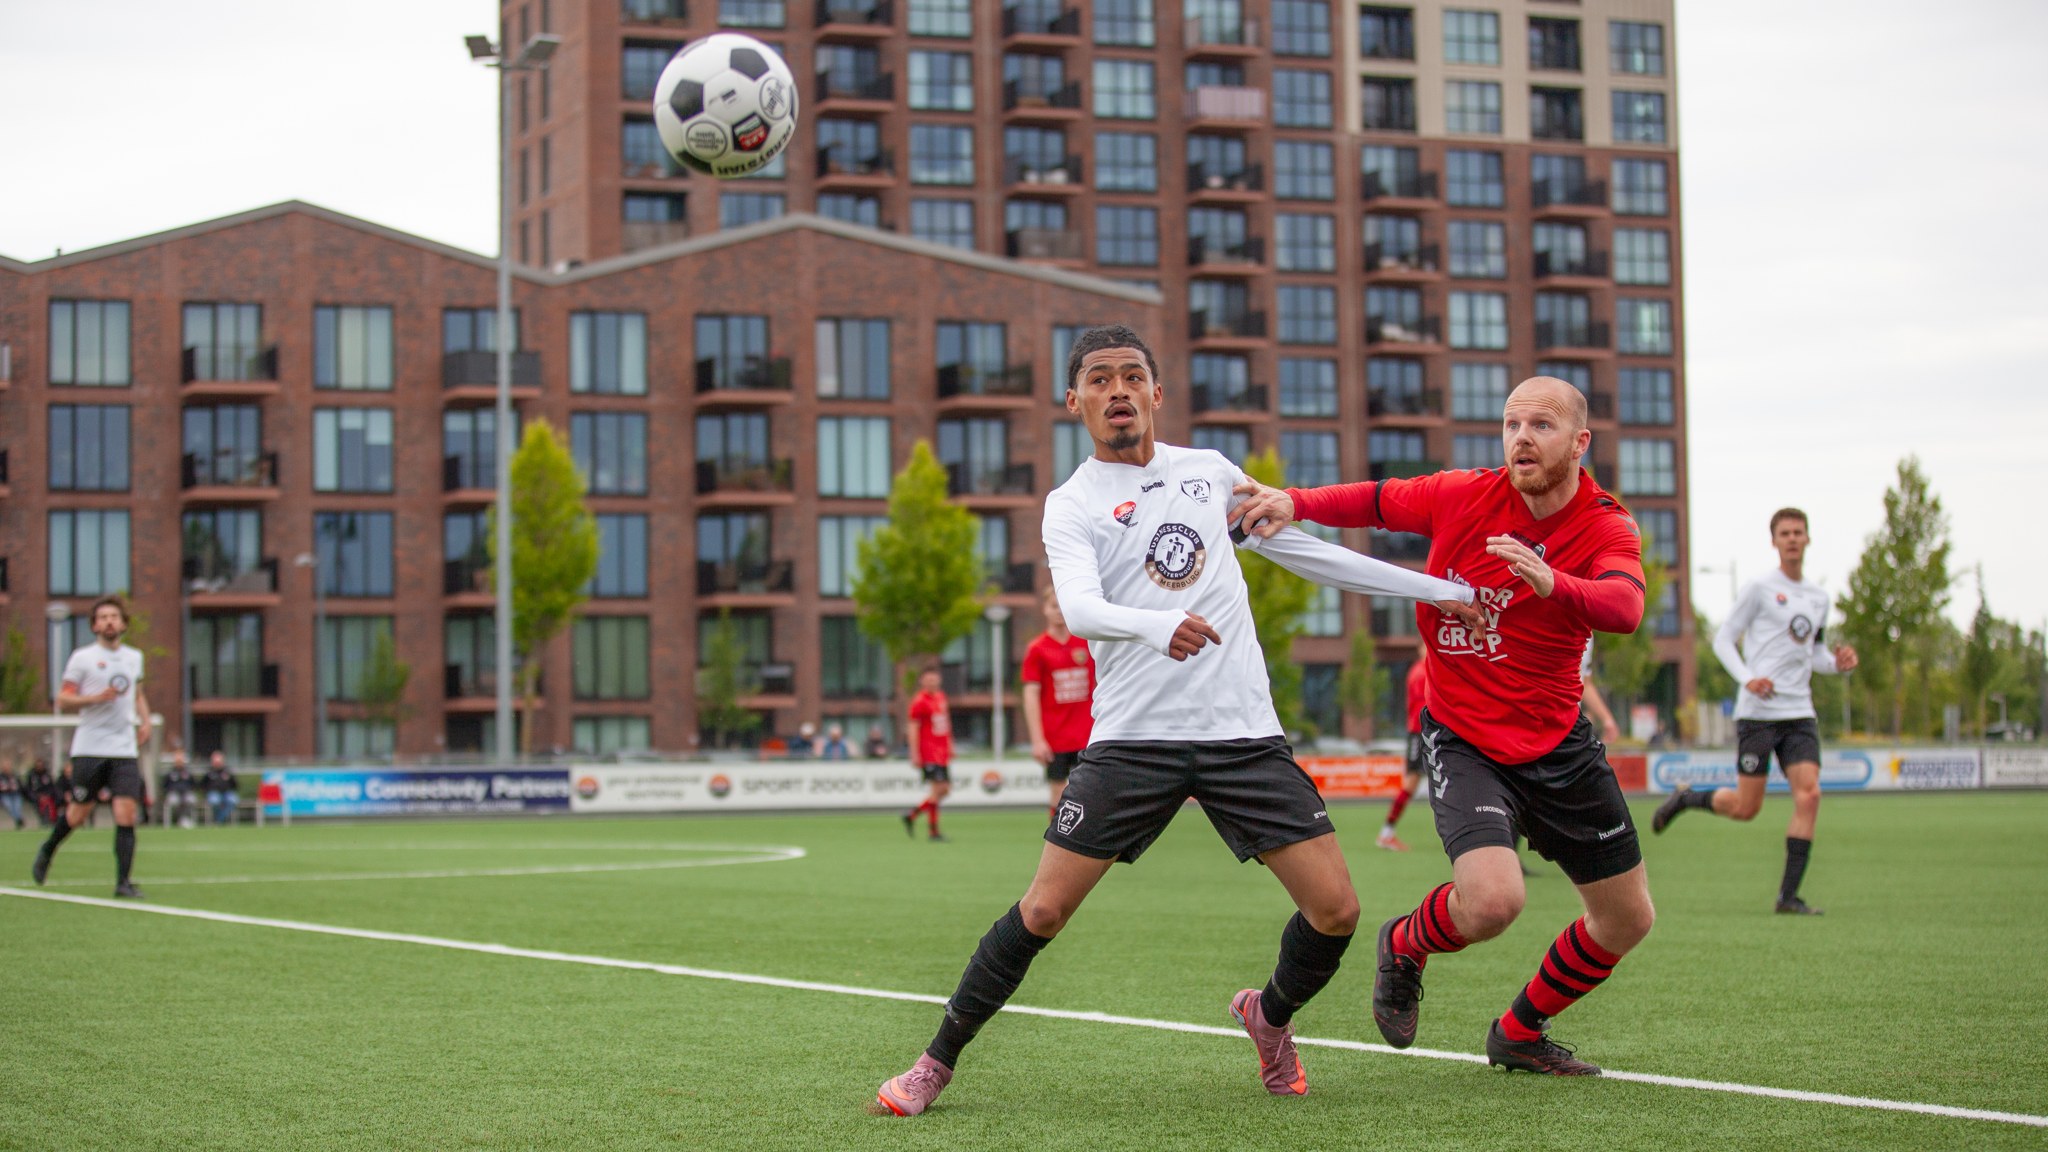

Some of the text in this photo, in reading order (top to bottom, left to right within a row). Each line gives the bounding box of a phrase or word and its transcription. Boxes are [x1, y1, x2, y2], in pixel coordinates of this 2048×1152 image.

[1149, 525, 1200, 556] BUSINESSCLUB
[1157, 557, 1194, 578] ZOETERWOUDE
[1160, 570, 1200, 588] MEERBURG
[365, 777, 489, 803] Connectivity
[491, 775, 569, 799] Partners
[742, 778, 803, 794] SPORT
[809, 778, 865, 794] 2000
[1599, 822, 1625, 839] hummel
